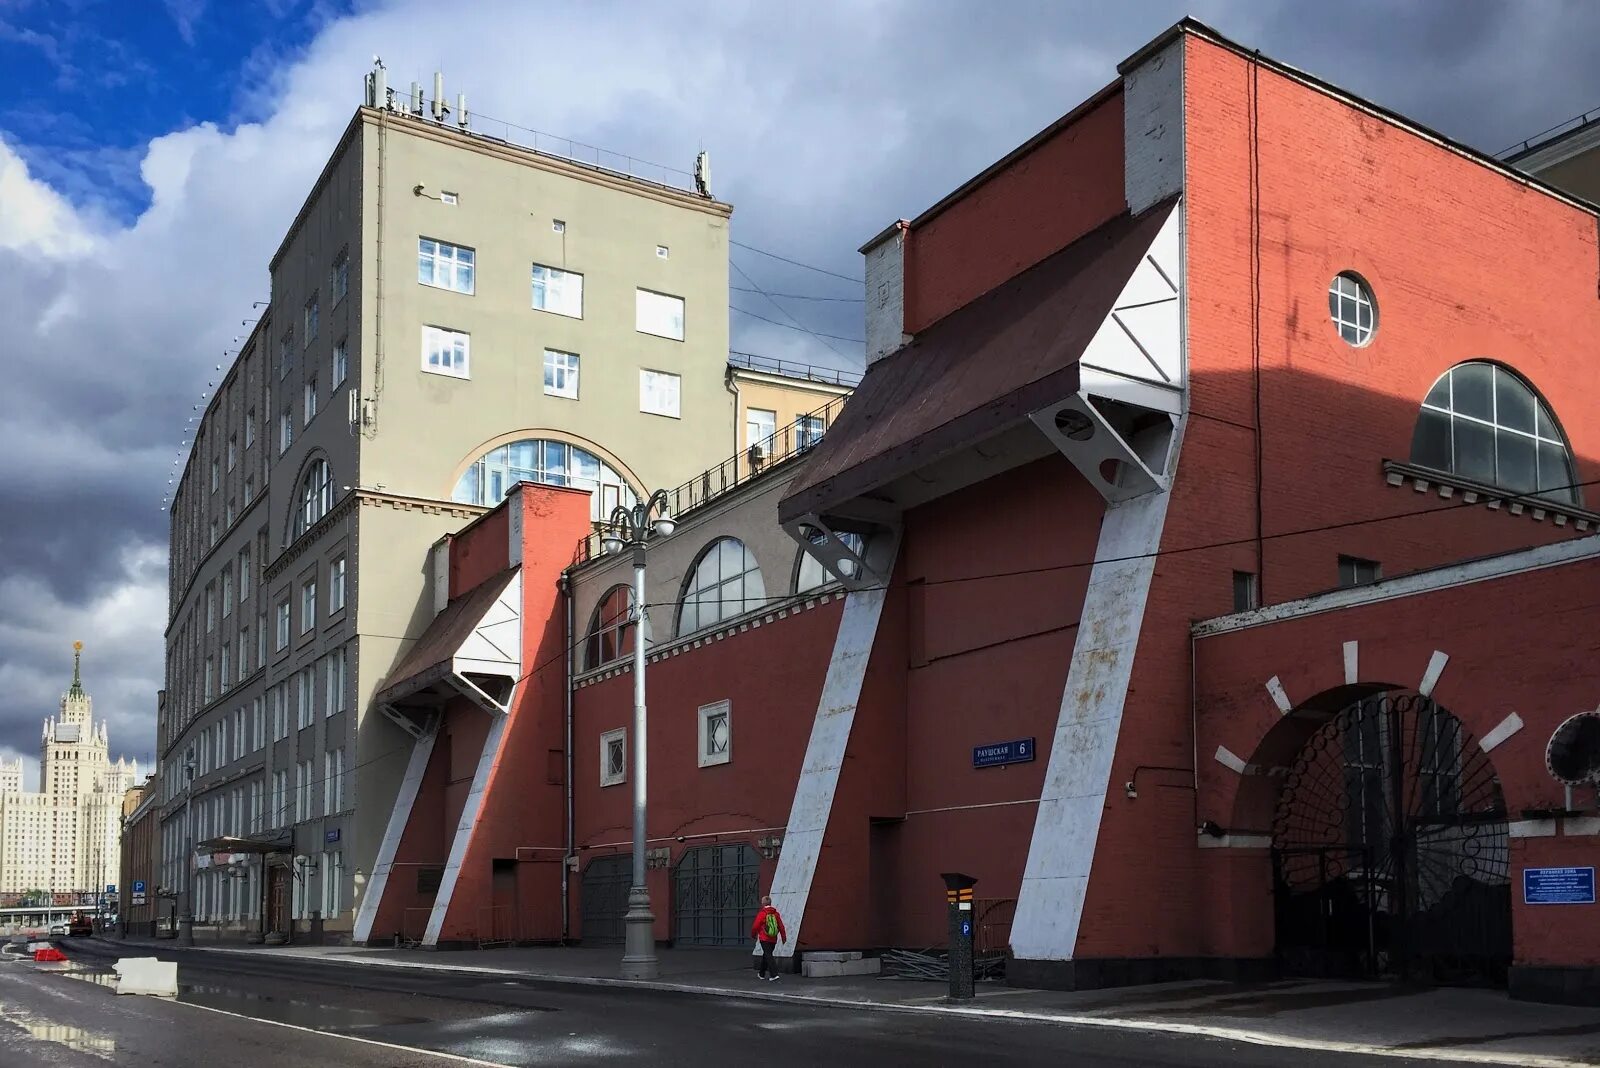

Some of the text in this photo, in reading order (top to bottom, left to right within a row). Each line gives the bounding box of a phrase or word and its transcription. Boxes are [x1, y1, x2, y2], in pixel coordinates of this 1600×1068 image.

[977, 743, 1026, 757] РАУШСКАЯ 6
[136, 882, 144, 891] P
[963, 924, 970, 934] P
